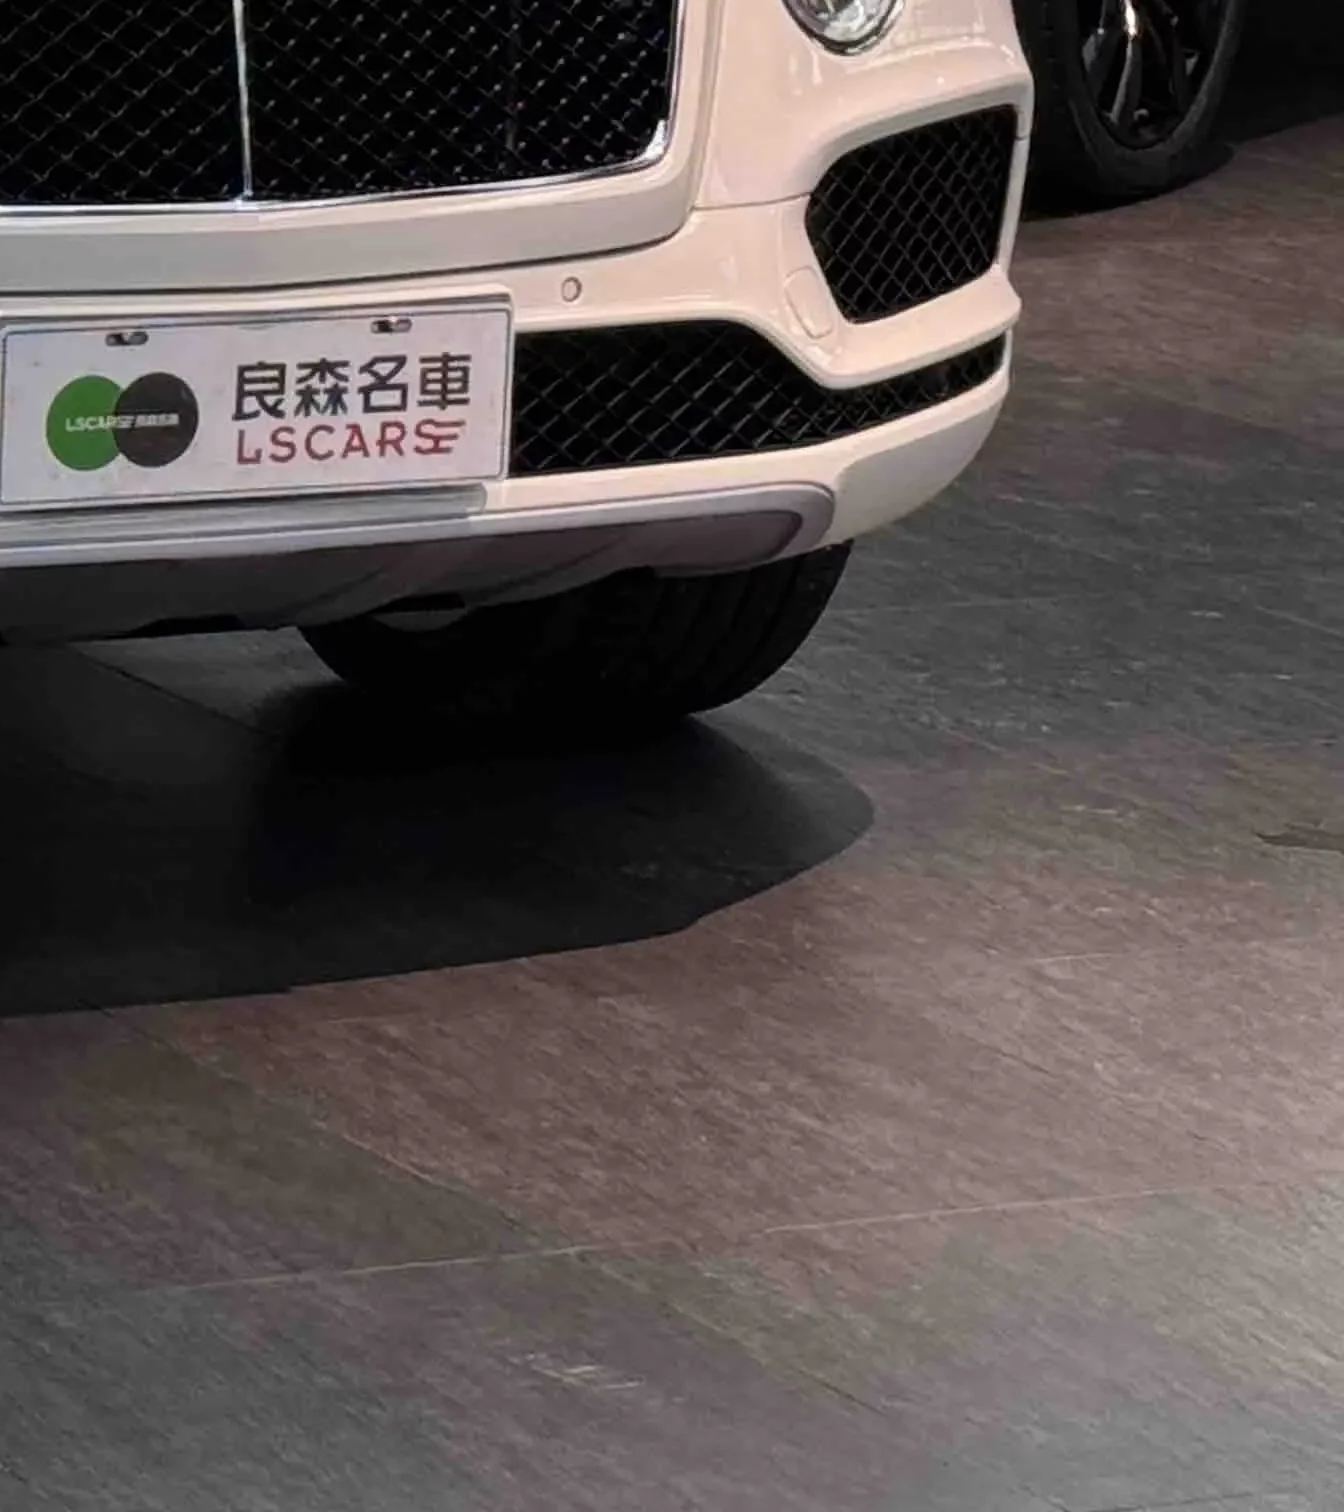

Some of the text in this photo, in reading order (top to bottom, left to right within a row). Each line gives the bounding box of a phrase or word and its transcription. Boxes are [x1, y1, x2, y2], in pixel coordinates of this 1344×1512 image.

[232, 352, 472, 421] 良森名車
[236, 418, 467, 465] LSCARS
